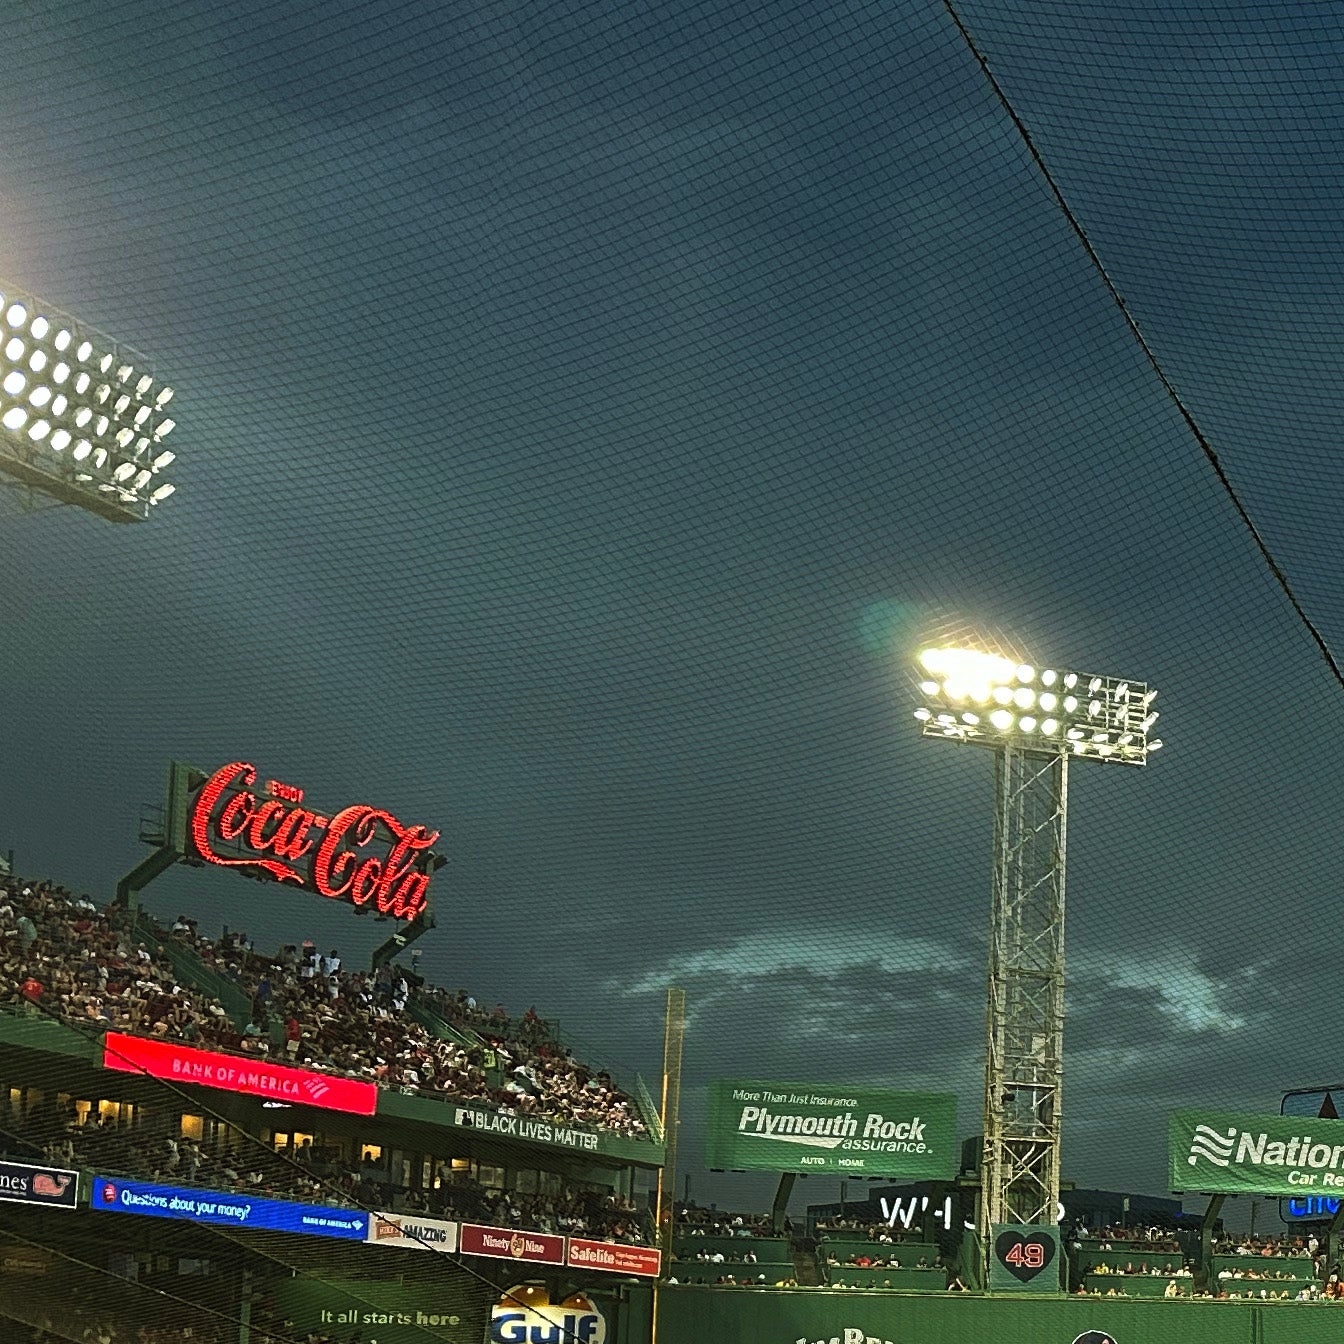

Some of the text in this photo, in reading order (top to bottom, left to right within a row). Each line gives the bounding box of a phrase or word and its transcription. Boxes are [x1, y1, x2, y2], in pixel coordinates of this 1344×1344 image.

[191, 762, 441, 921] Coca-Cola
[172, 1058, 300, 1095] BANK OF AMERICA
[733, 1089, 808, 1105] More Than Just
[474, 1112, 598, 1150] BLACK LIVES MATTER
[738, 1106, 927, 1141] Plymouth Rock
[842, 1138, 926, 1154] assurance
[800, 1156, 825, 1166] AUTO
[1287, 1171, 1318, 1187] Car
[121, 1190, 251, 1220] Questions about your money?
[570, 1245, 615, 1264] Safelite
[1005, 1243, 1044, 1268] 49
[321, 1309, 461, 1328] It all starts here
